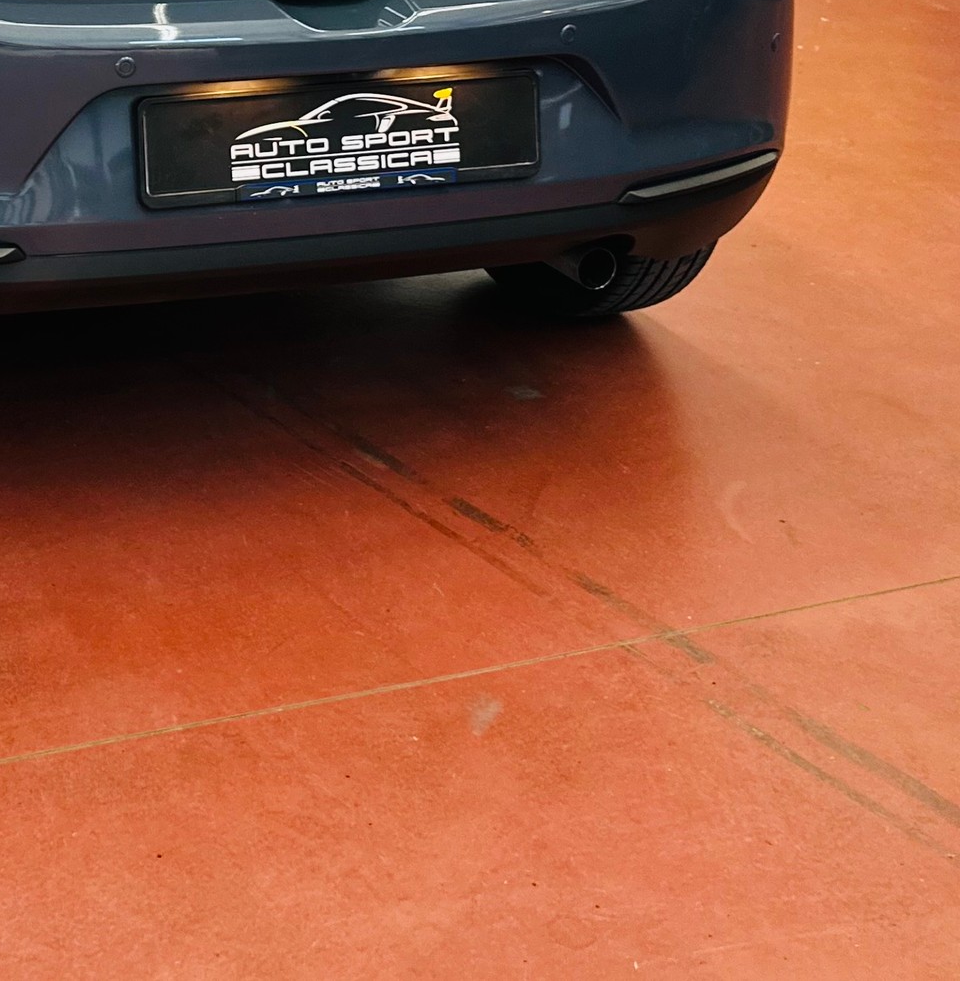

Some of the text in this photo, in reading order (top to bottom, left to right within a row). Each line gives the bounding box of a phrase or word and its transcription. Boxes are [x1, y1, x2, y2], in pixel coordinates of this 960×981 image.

[230, 126, 460, 160] AUTO SPORT
[261, 150, 433, 179] CLASSICA
